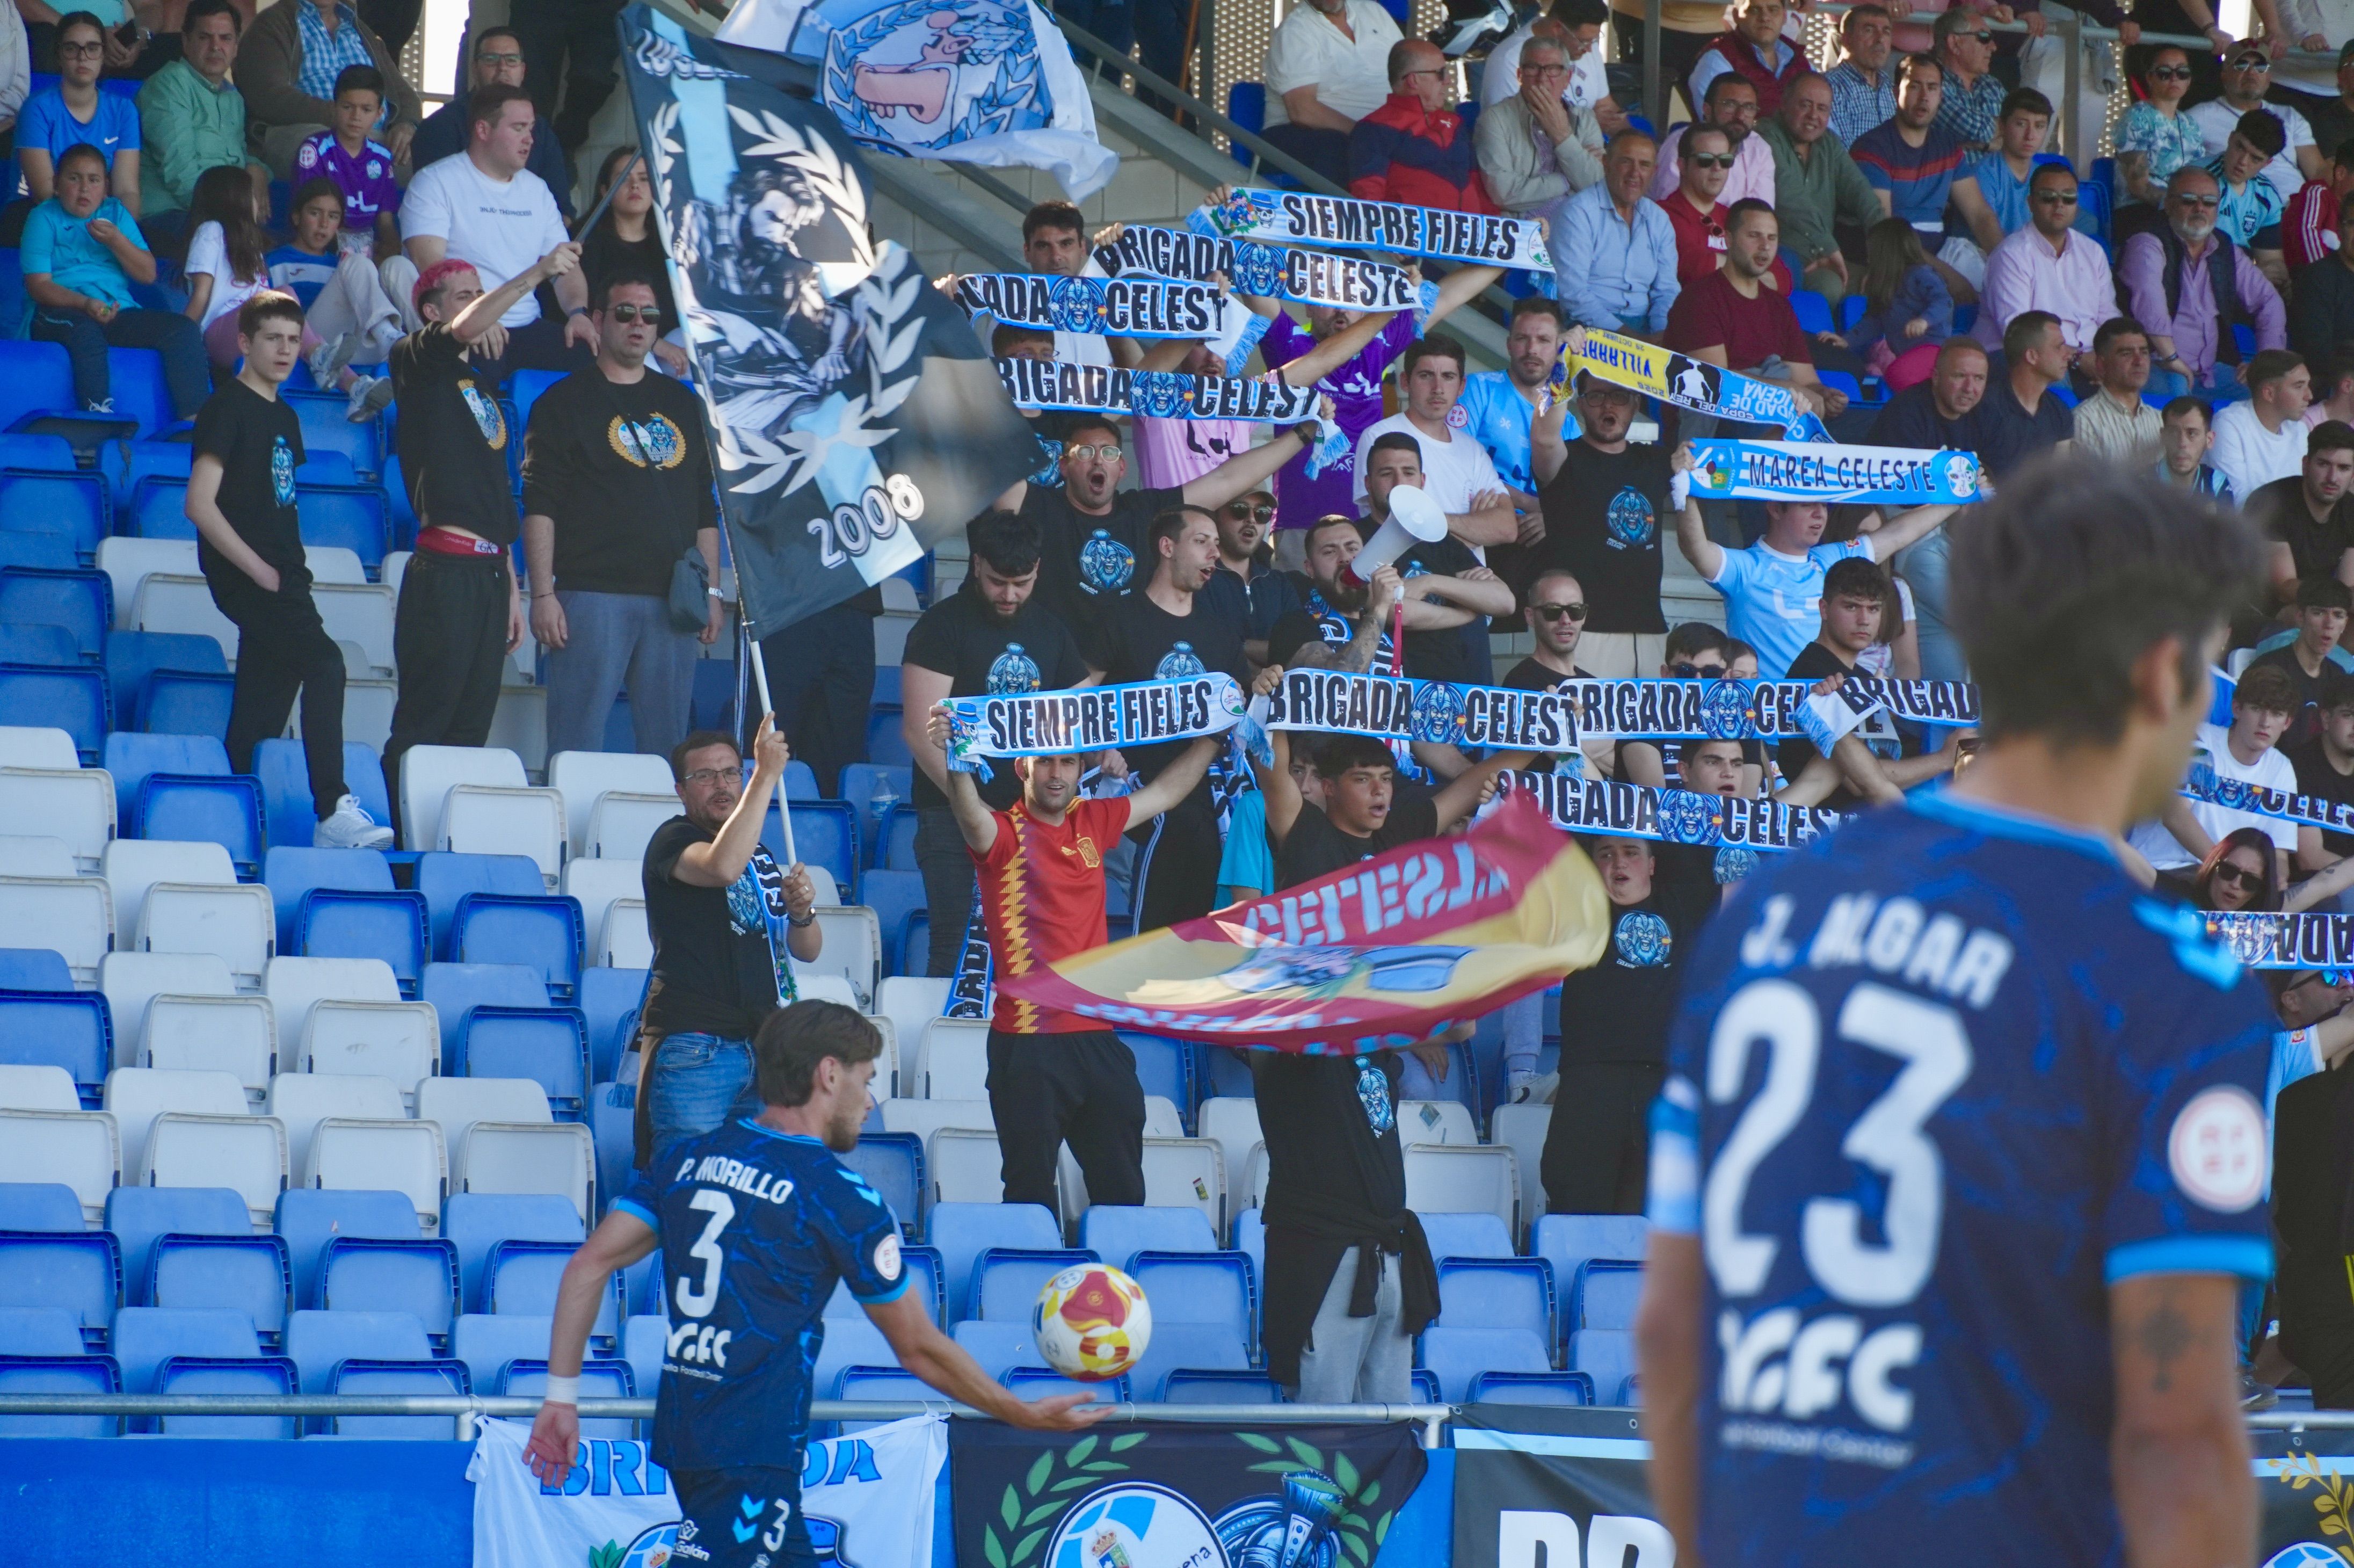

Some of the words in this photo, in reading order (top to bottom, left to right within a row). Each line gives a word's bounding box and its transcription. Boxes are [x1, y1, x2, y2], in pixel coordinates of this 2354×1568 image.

[1282, 194, 1420, 249] SIEMPRE
[1426, 209, 1520, 260] FIELES
[1287, 249, 1417, 307] CELESTE
[1107, 282, 1224, 332] CELEST
[990, 357, 1131, 408] RIGADA
[1669, 392, 1692, 406] REY
[1696, 399, 1717, 413] DEL
[1720, 405, 1756, 420] COPA
[1748, 454, 1828, 488] MAREA
[1837, 458, 1937, 492] CELESTE
[807, 473, 925, 569] 2008
[987, 693, 1117, 750] SIEMPRE
[1123, 680, 1212, 741] FIELES
[1740, 895, 1797, 967] J.
[1704, 978, 1975, 1309] 23
[675, 1158, 692, 1181] P.
[695, 1155, 794, 1205] MORILLO
[675, 1188, 736, 1318] 3
[763, 1498, 790, 1552] 3
